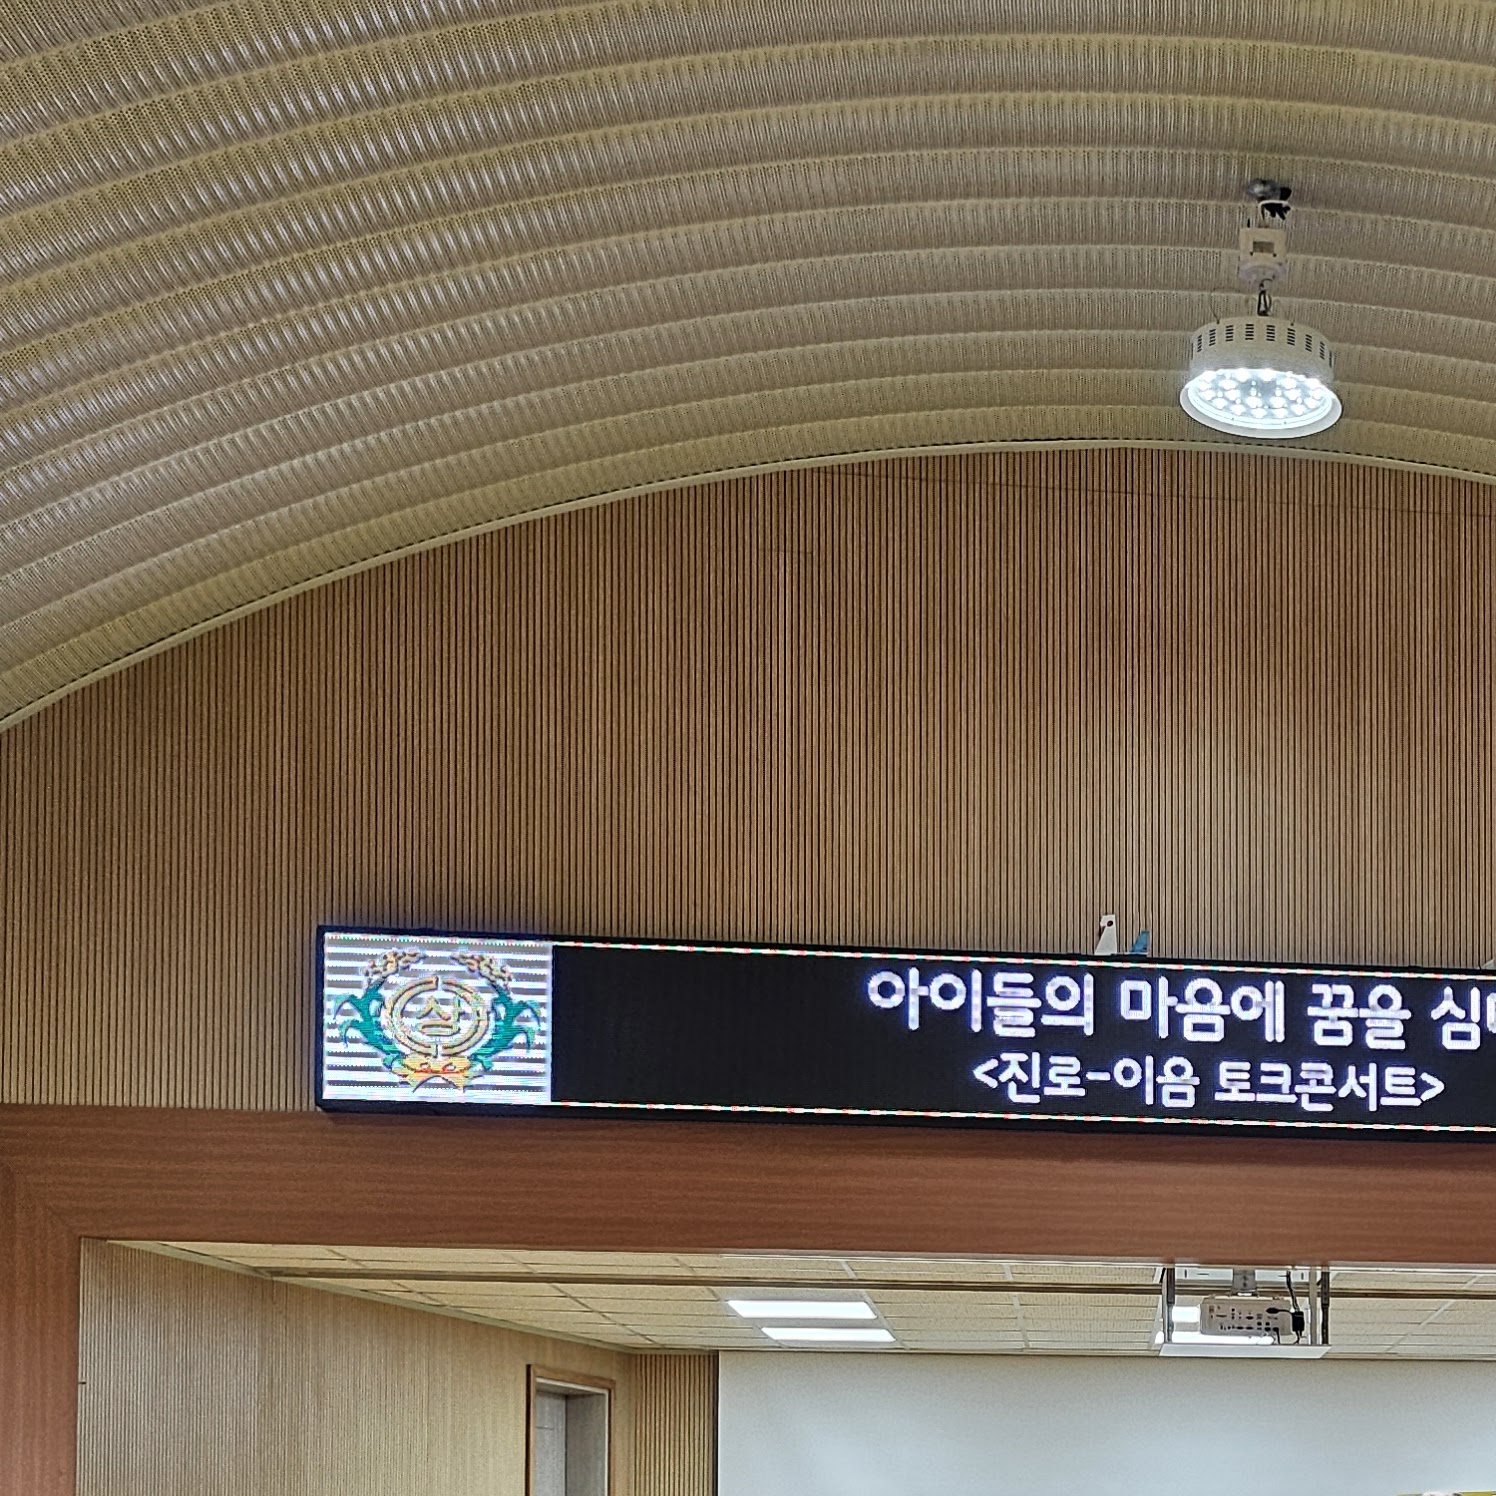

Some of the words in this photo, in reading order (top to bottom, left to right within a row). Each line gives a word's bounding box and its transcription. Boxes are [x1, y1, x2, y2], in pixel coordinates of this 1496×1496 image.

[867, 967, 1094, 1037] 아이들의
[1120, 976, 1285, 1043] 마음에
[1307, 983, 1411, 1050] 꿈을
[972, 1051, 1201, 1108] <진로-이음
[1214, 1061, 1445, 1112] 토크콘서트>
